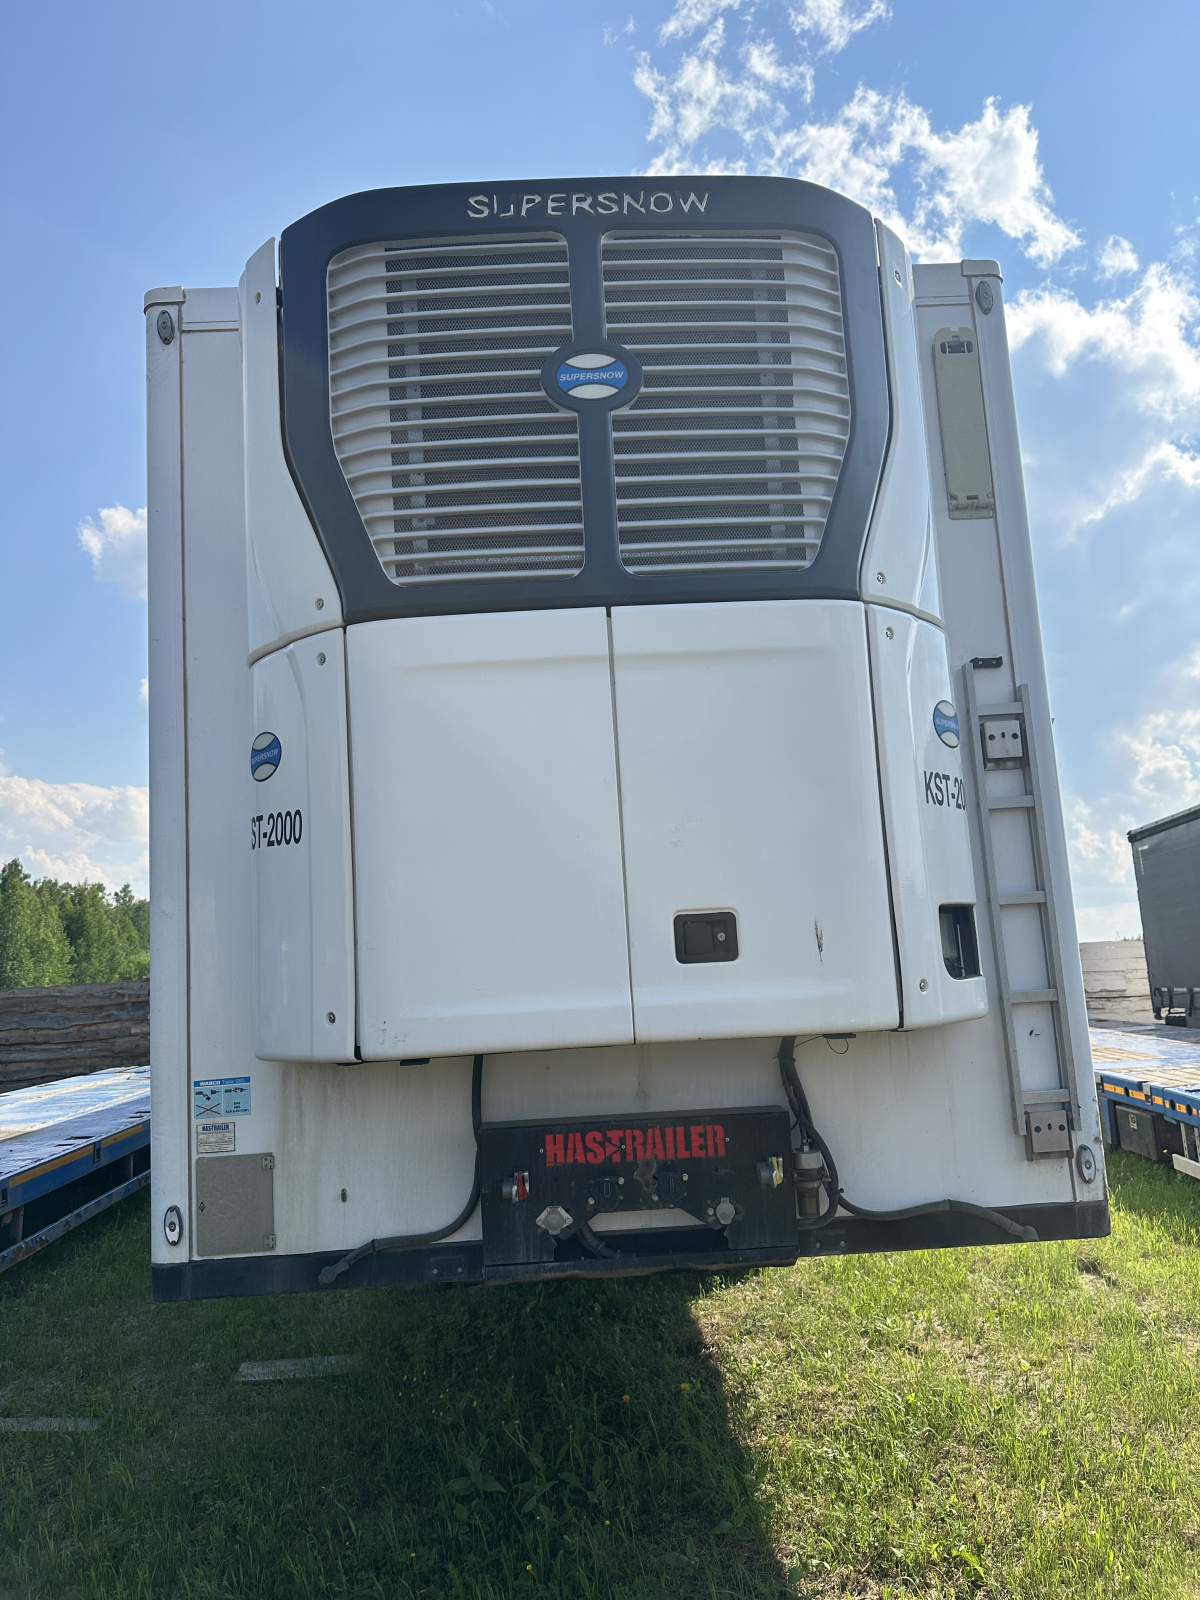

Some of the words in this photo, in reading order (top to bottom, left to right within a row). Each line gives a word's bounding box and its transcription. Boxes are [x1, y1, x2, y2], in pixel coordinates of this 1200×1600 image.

[467, 191, 709, 218] SUPERSNOW
[560, 370, 624, 382] SUPERSNOW
[545, 1124, 727, 1167] HASTRAILER
